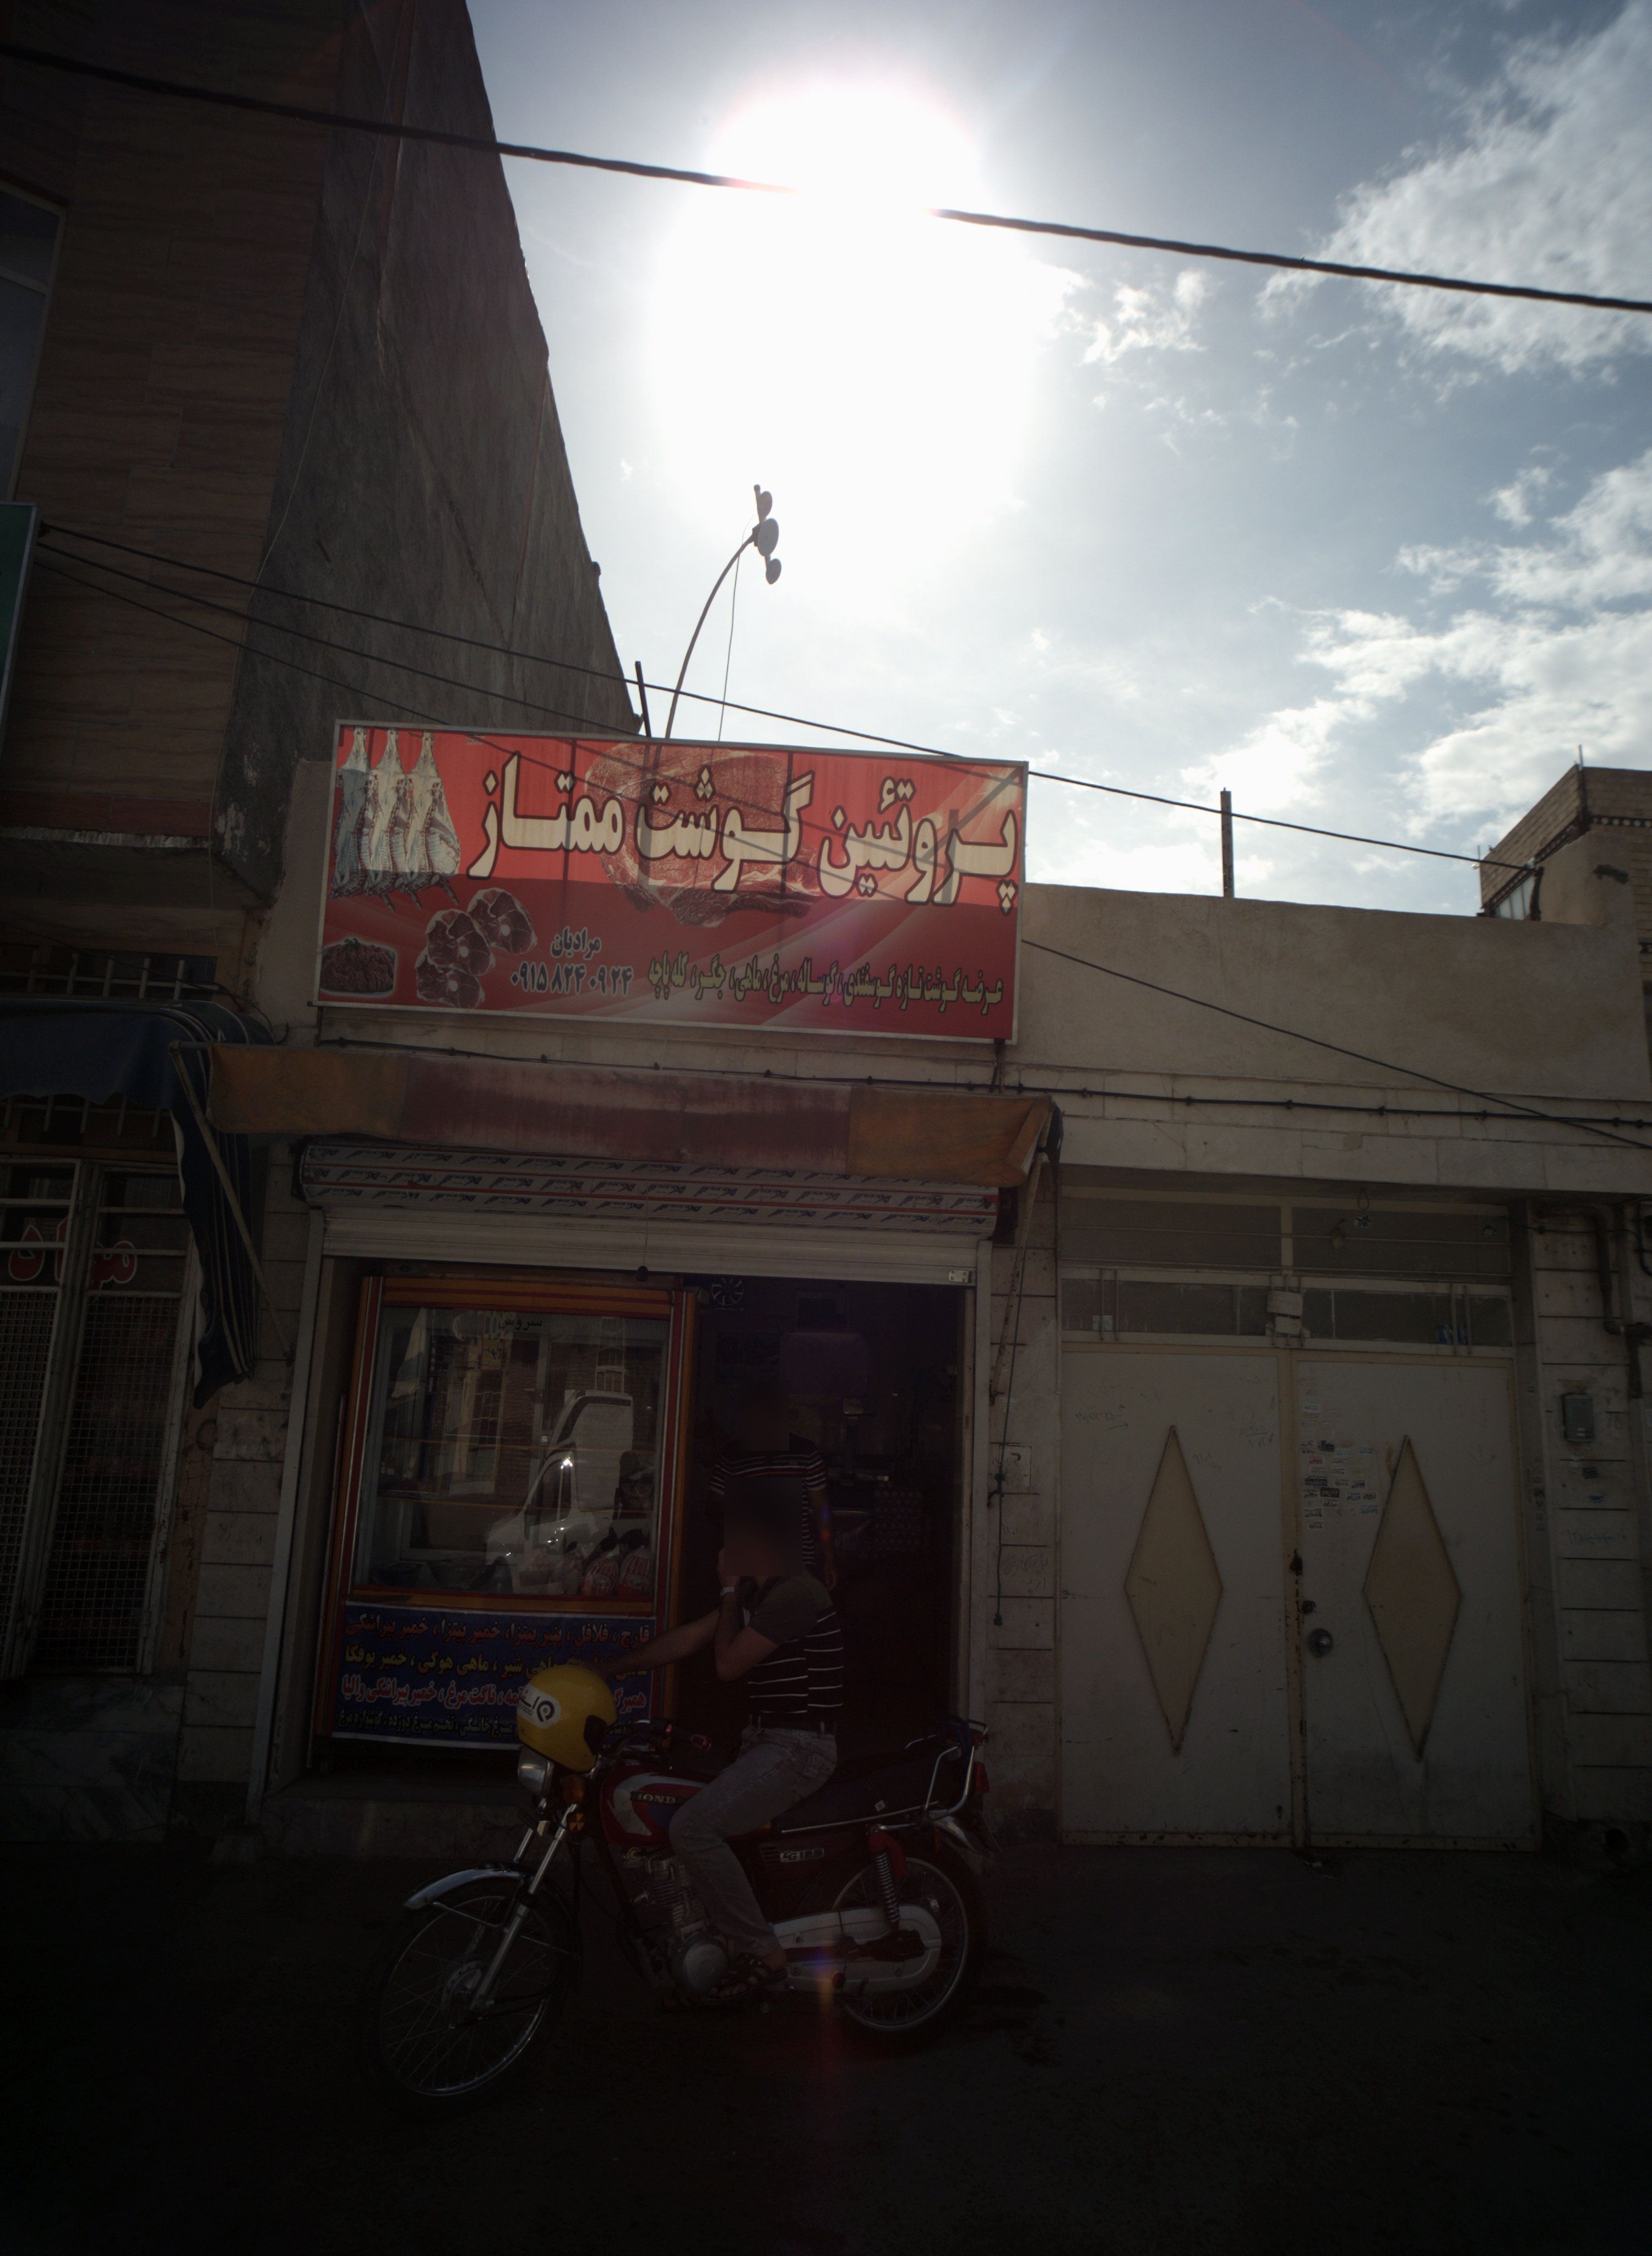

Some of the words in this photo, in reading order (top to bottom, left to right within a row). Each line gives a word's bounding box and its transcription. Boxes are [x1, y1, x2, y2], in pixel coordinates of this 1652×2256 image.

[466, 751, 626, 880] ممتاز
[634, 764, 814, 893] گوشت
[818, 776, 1018, 915] پروتئین
[551, 926, 602, 960] مرادیان
[896, 964, 924, 1011] تازه
[923, 967, 962, 1012] گوشت
[962, 970, 1003, 1015] عرضه
[345, 1613, 396, 1639] پیراشکی
[397, 1617, 429, 1640] خمیر
[469, 1622, 501, 1644] خمیر
[539, 1625, 562, 1648] پنیر
[377, 1647, 407, 1671] خمیر
[456, 1652, 489, 1677] ماهی
[366, 1677, 409, 1706] پیراشکی
[409, 1680, 437, 1706] خمیر
[469, 1683, 497, 1705] ناگت
